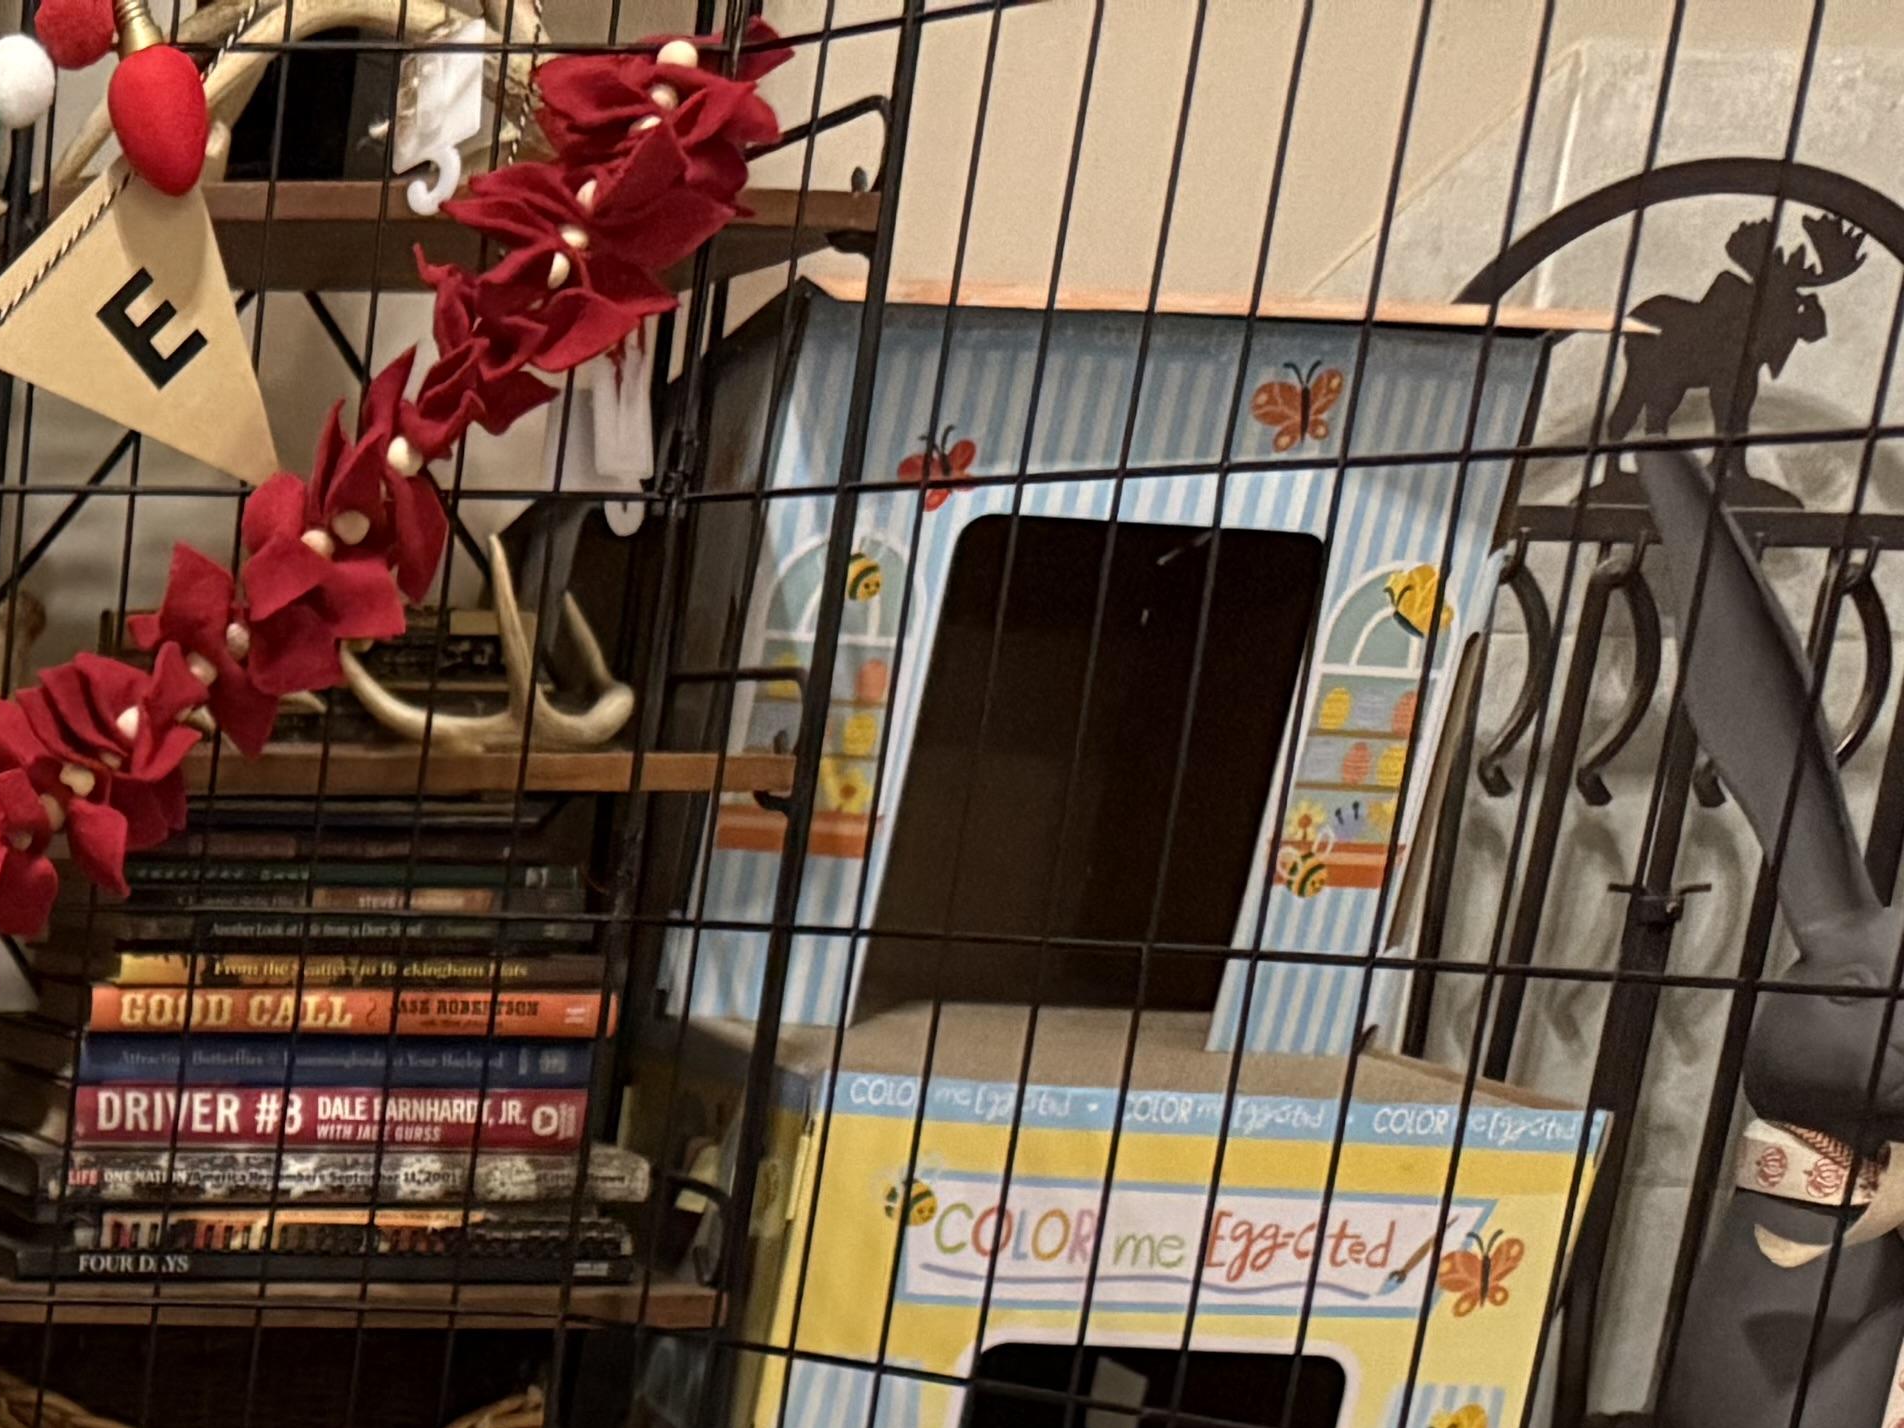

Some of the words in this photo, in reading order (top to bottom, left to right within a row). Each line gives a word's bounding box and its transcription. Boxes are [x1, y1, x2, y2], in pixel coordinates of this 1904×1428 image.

[392, 1000, 431, 1016] ASE
[96, 1090, 240, 1133] DRIVER
[317, 1095, 366, 1121] DALE
[498, 1099, 527, 1124] JR.
[849, 1077, 919, 1108] COLO
[1373, 1108, 1450, 1135] COLOR
[316, 1123, 352, 1140] WITH
[68, 1168, 99, 1185] LIFE
[933, 1201, 1096, 1259] COLOR
[1111, 1230, 1186, 1270] me
[1204, 1208, 1397, 1285] Egg-cted
[78, 1254, 133, 1273] FOUR
[138, 1254, 190, 1273] DYS
